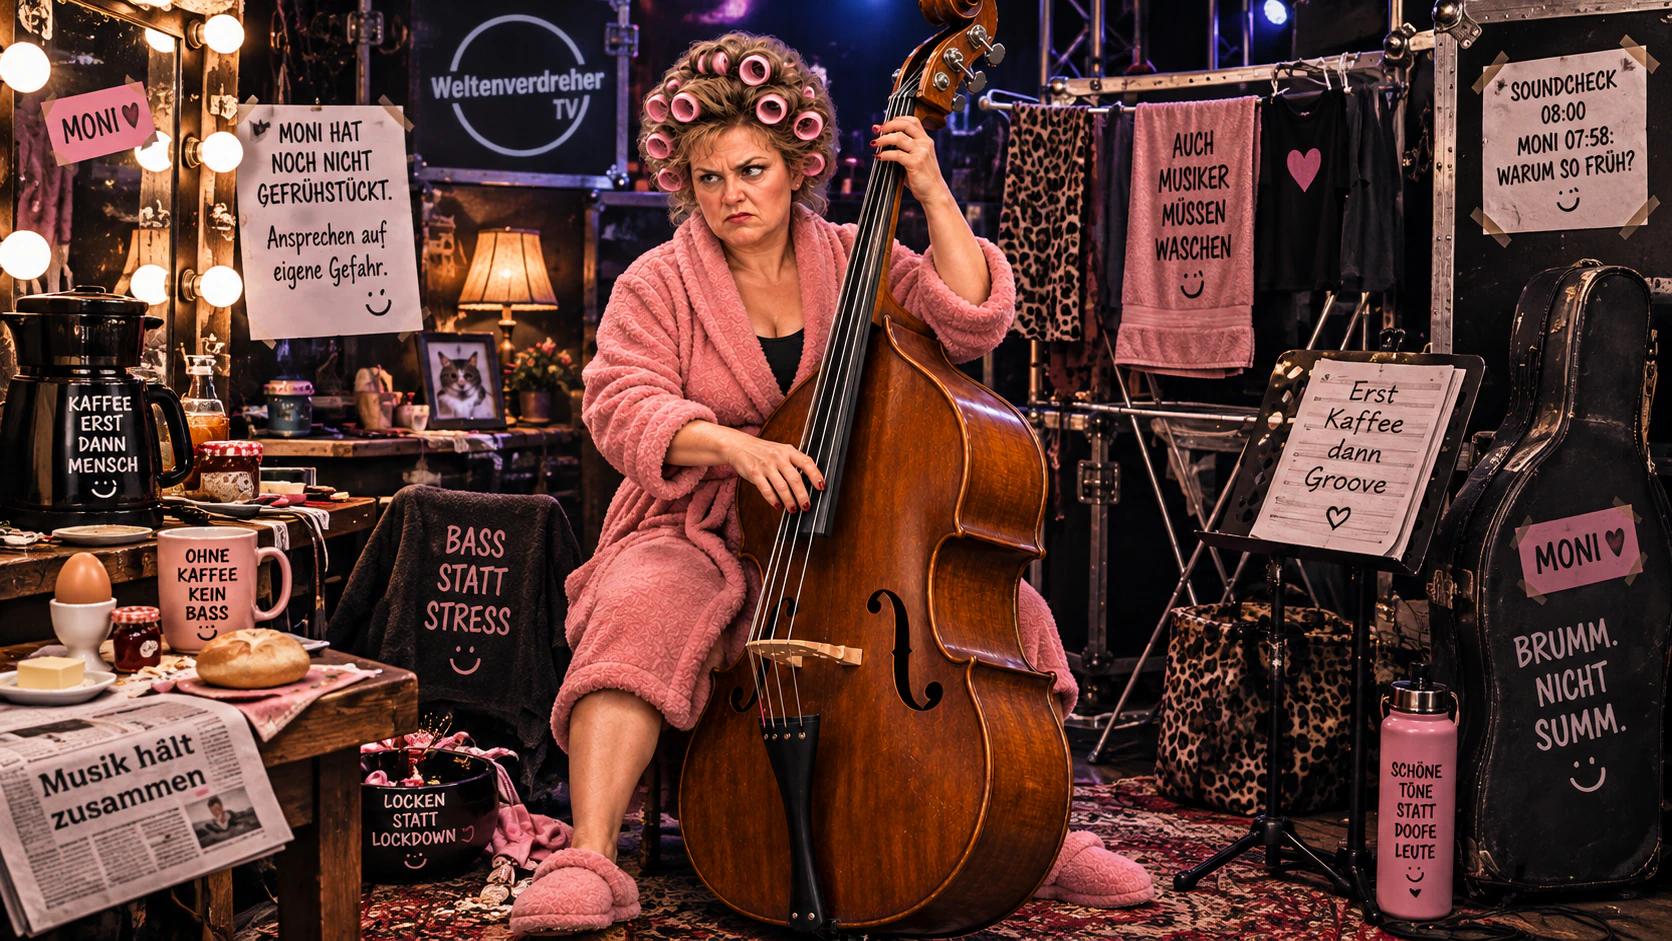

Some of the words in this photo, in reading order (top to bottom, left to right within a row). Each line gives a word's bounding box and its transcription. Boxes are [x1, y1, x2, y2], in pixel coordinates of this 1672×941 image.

[431, 68, 605, 99] Weltenverdreher
[1511, 69, 1617, 101] SOUNDCHECK
[553, 98, 579, 120] TV
[1541, 101, 1586, 124] 08:00
[62, 107, 119, 144] MONI
[279, 122, 322, 143] MONI
[330, 121, 362, 142] HAT
[1172, 130, 1214, 158] AUCH
[1517, 132, 1558, 156] MONI
[1565, 126, 1614, 150] 07:58:
[271, 152, 316, 174] NOCH
[323, 150, 372, 172] NICHT
[1497, 161, 1555, 186] WARUM
[1560, 158, 1580, 179] SO
[1585, 150, 1635, 176] FRÜH?
[1158, 164, 1230, 193] MUSIKER
[257, 179, 392, 207] GEFRÜHSTÜCKT.
[1162, 197, 1226, 226] MÜSSEN
[267, 222, 355, 255] Ansprechen
[361, 219, 388, 249] auf
[1155, 234, 1231, 261] WASCHEN
[273, 264, 323, 290] eigene
[329, 255, 388, 284] Gefahr.
[68, 395, 133, 412] KAFFEE
[1349, 381, 1399, 404] Erst
[80, 415, 123, 432] ERST
[1324, 407, 1404, 435] Kaffee
[78, 436, 126, 452] DANN
[1327, 438, 1382, 463] dann
[68, 456, 138, 474] MENSCH
[1304, 466, 1387, 494] Groove
[446, 525, 506, 558] BASS
[1535, 532, 1601, 575] MONI
[185, 548, 230, 563] OHNE
[177, 567, 238, 583] KAFFEE
[437, 563, 509, 596] STATT
[189, 586, 226, 602] KEIN
[185, 605, 229, 621] BASS
[424, 600, 511, 636] STRESS
[1513, 617, 1619, 669] BRUMM.
[1535, 660, 1608, 708] NICHT
[1534, 702, 1627, 752] SUMM.
[38, 752, 131, 798] Musik
[1390, 760, 1443, 779] SCHÖNE
[51, 768, 207, 831] zusammen
[384, 792, 446, 809] LOCKEN
[1399, 780, 1433, 799] TÖNE
[392, 811, 439, 828] STATT
[1396, 802, 1437, 819] STATT
[371, 828, 456, 847] LOCKDOWN
[1395, 822, 1437, 839] DOOFE
[1395, 843, 1436, 860] LEUTE
